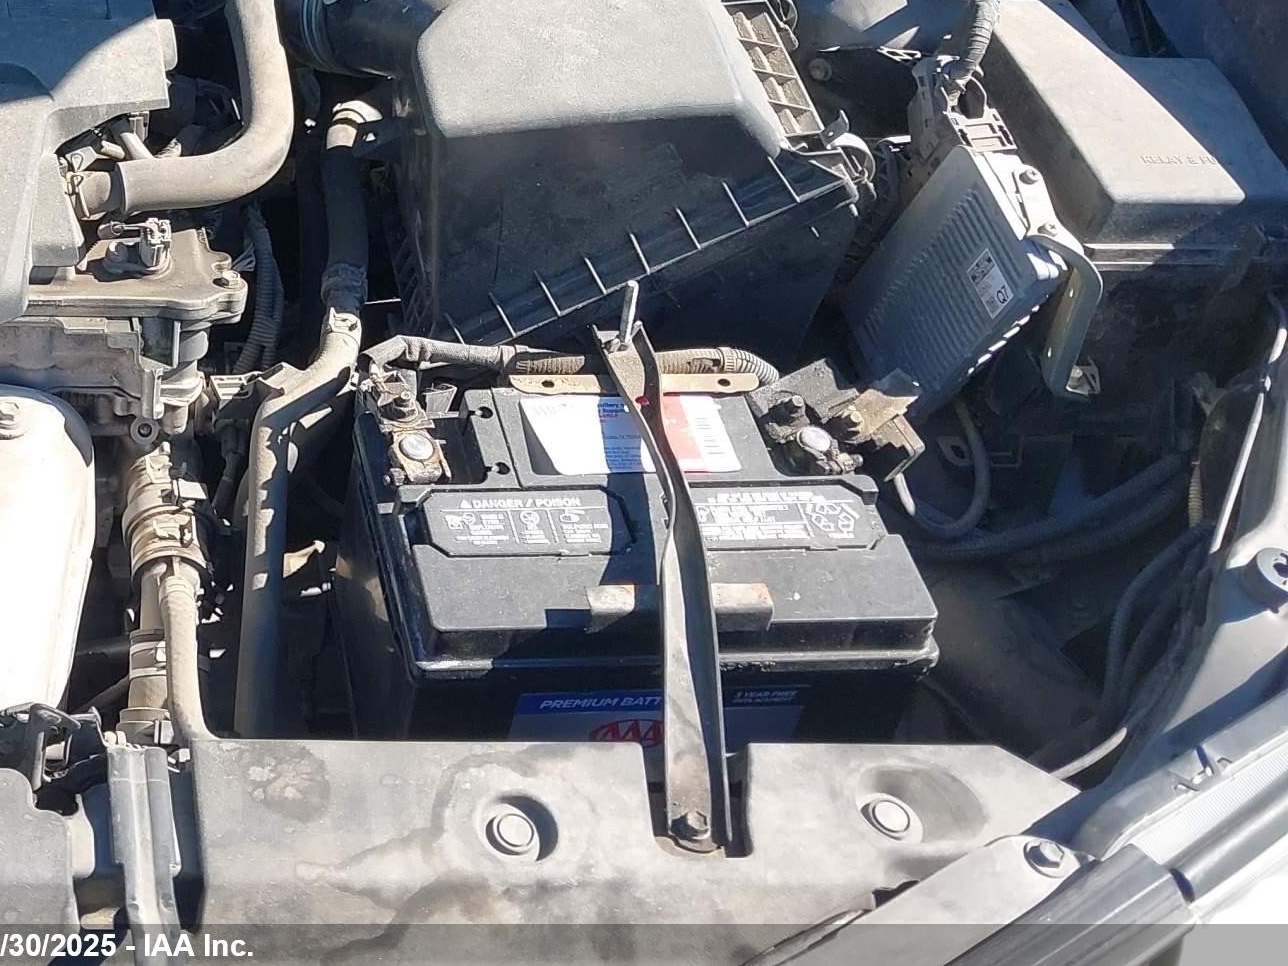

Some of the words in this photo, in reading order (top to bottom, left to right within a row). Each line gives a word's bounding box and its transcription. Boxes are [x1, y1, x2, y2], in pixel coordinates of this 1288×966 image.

[472, 497, 524, 509] DANGER
[534, 496, 582, 508] POISON
[539, 696, 618, 710] PREMIUM
[619, 695, 663, 707] BATT
